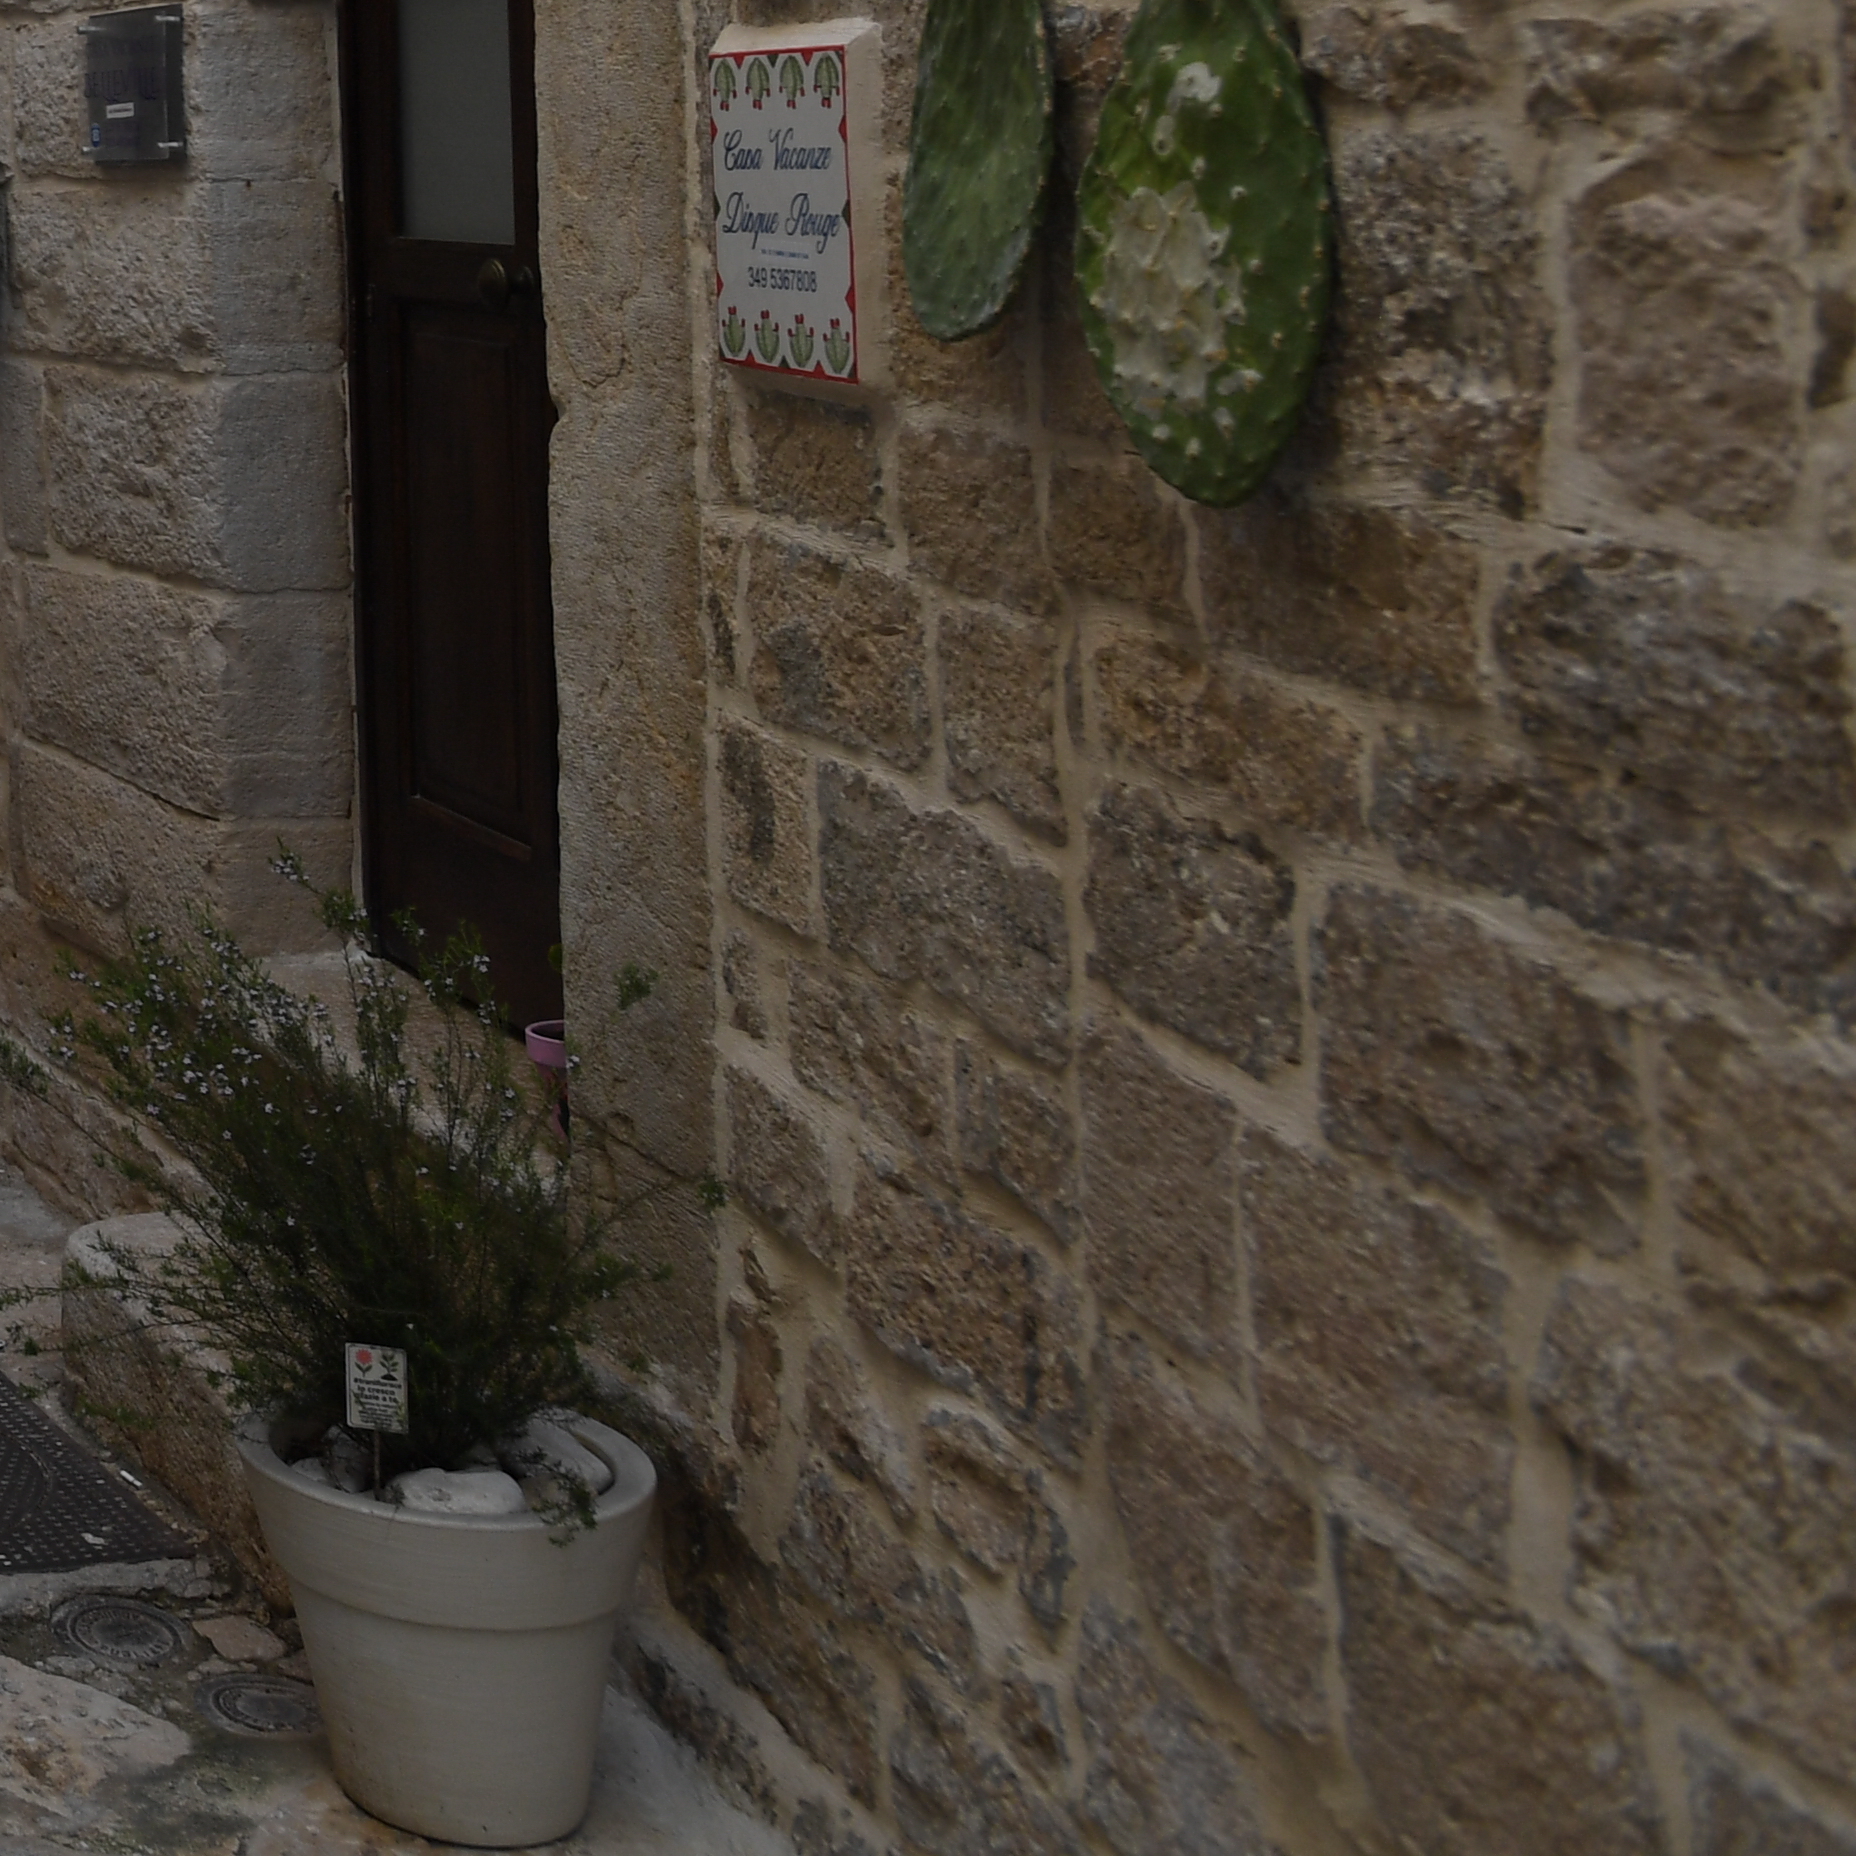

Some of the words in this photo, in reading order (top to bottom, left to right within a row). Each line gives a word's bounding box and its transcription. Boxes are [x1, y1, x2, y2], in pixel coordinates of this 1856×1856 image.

[723, 129, 763, 171] Casa
[768, 127, 832, 171] Vacanze
[722, 191, 779, 250] Disque
[785, 192, 841, 254] Rouge
[747, 266, 767, 288] 349
[770, 268, 818, 292] 5367808
